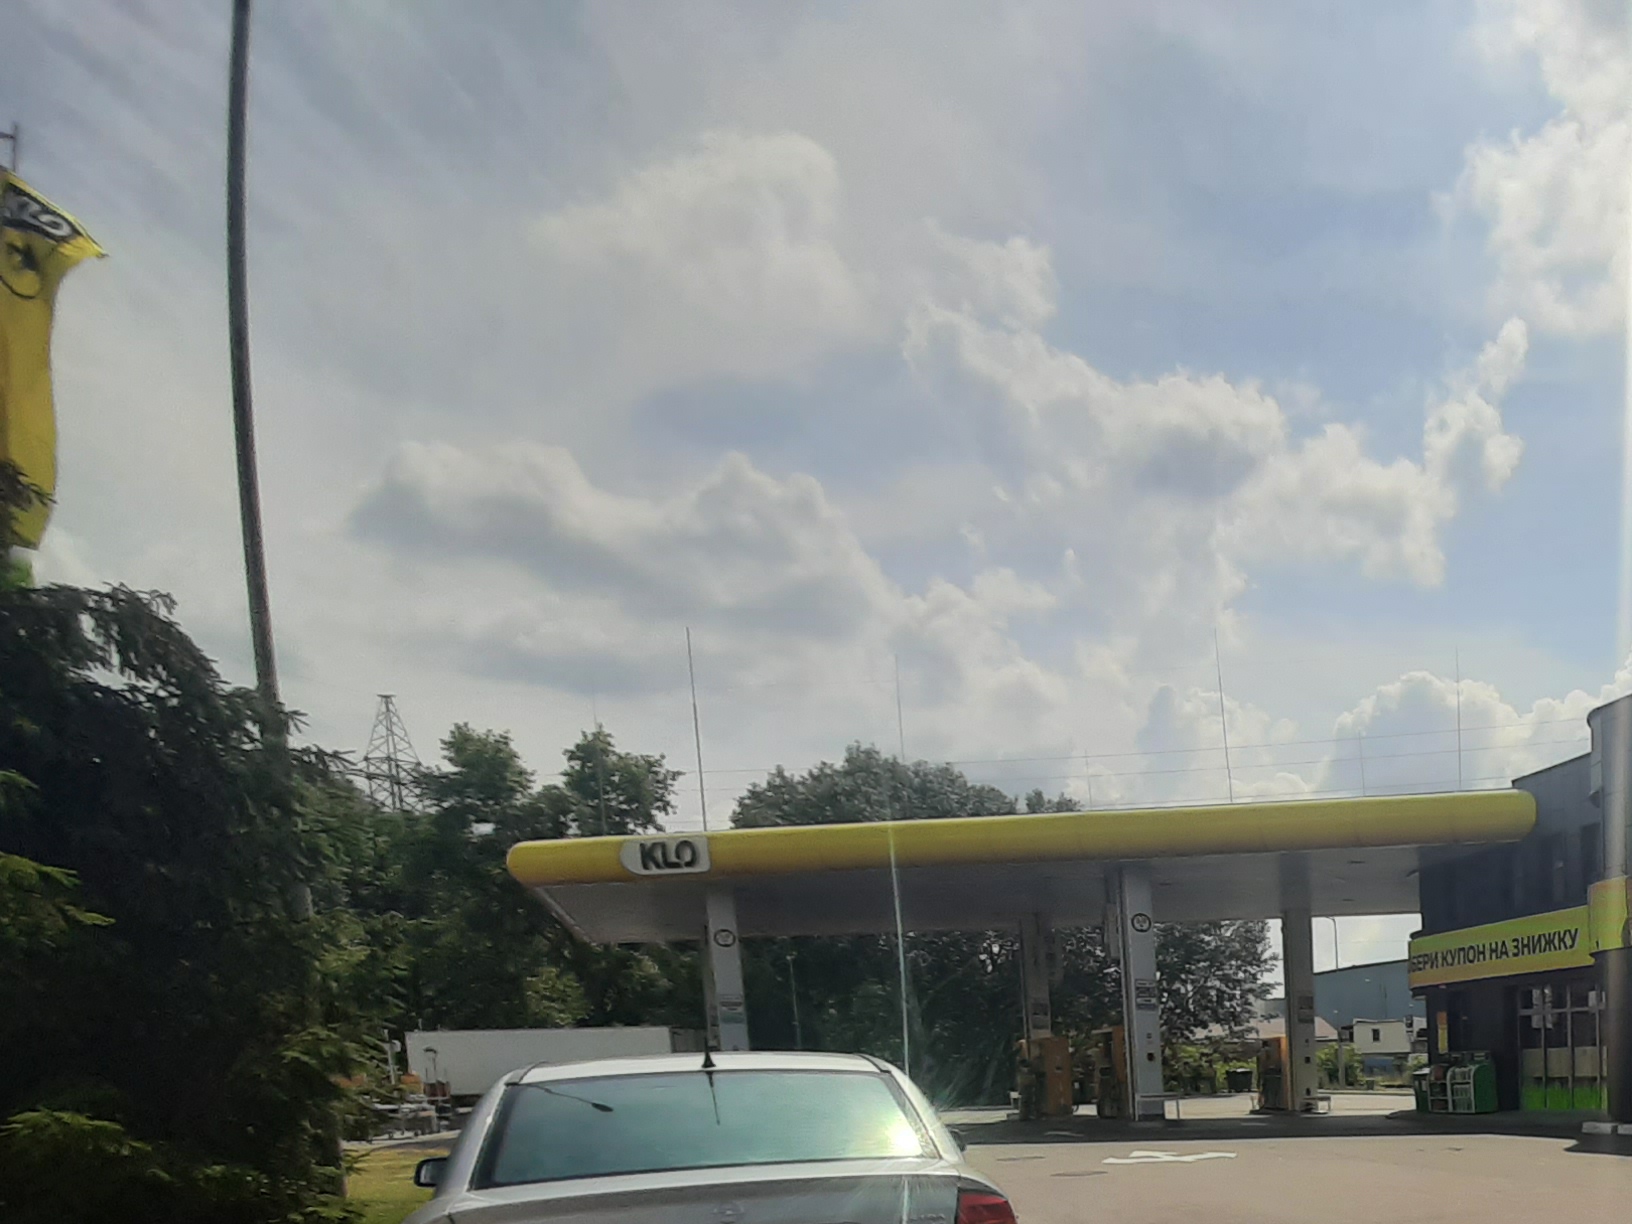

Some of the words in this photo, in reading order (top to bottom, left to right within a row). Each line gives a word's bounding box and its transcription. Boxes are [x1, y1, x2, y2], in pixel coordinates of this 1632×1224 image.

[640, 840, 698, 871] KLO
[1409, 951, 1439, 973] БЕРИ
[1441, 944, 1486, 967] КУПОН
[1490, 940, 1509, 960] НА
[1512, 928, 1578, 956] ЗНИЖКУ
